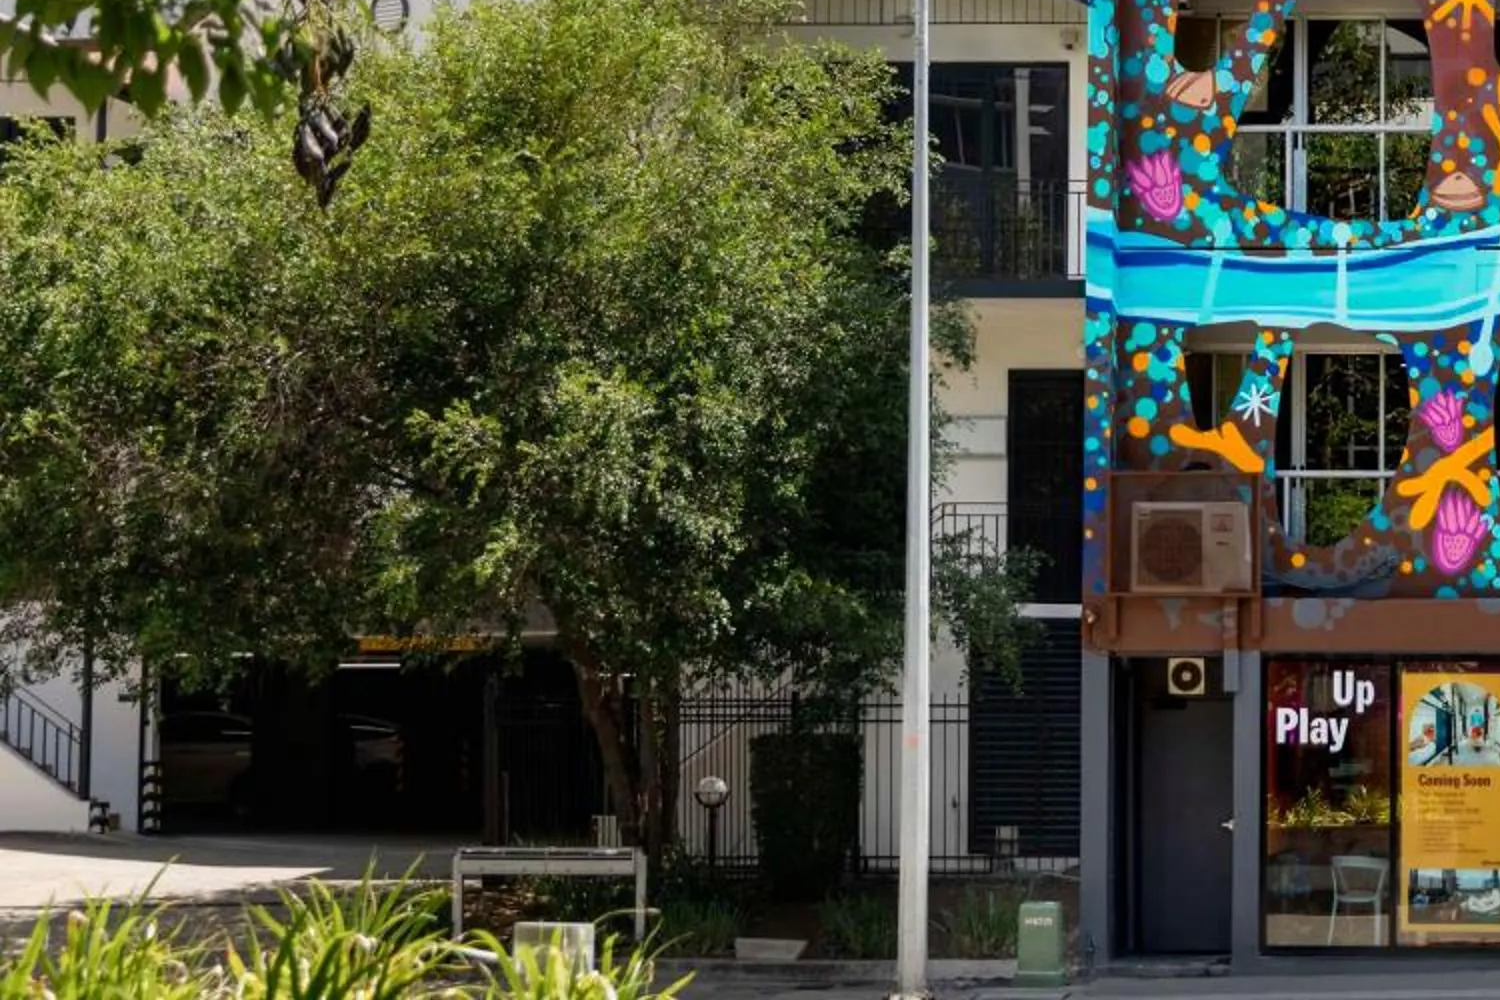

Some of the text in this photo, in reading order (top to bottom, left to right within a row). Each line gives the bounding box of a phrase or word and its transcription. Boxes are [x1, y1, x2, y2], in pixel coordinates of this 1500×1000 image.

[1332, 669, 1375, 714] Up
[1276, 706, 1349, 754] Play
[1418, 773, 1491, 788] Coming Soon
